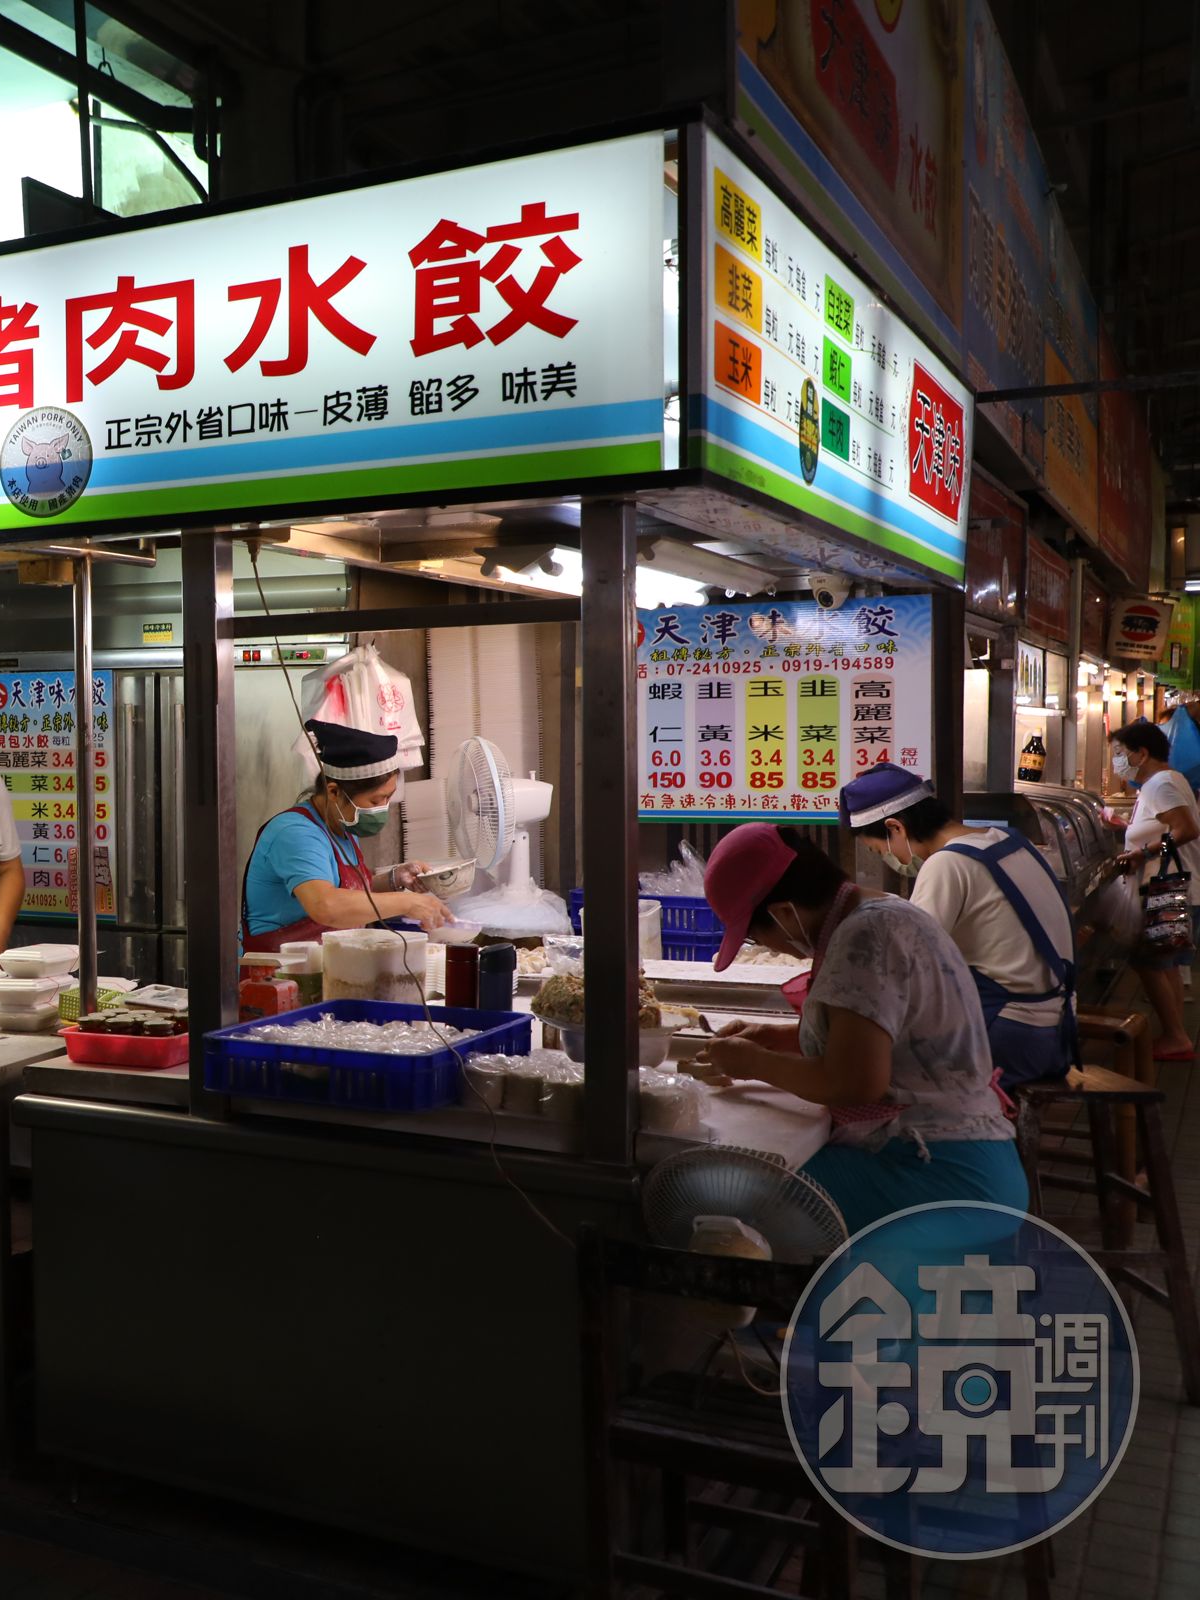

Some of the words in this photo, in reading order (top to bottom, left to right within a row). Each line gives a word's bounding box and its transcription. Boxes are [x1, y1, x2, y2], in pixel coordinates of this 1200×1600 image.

[720, 184, 758, 251] 高麗菜
[728, 263, 753, 319] 韭菜
[728, 338, 753, 391] 玉米
[408, 373, 480, 416] 餡多
[501, 361, 577, 405] 味美
[8, 415, 38, 445] TAIWAN
[41, 412, 65, 424] PORK
[65, 421, 83, 442] ONLY
[913, 389, 960, 504] 天津味
[7, 477, 39, 511] 本店使用
[782, 656, 894, 672] 0919-194589
[11, 680, 107, 709] 天津味餃
[649, 682, 683, 743] 蝦仁
[697, 682, 732, 743] 韭黃
[748, 680, 784, 742] 玉米
[800, 680, 837, 742] 韭菜
[853, 680, 892, 744] 高麗菜
[52, 735, 70, 746] 每粒
[52, 752, 74, 767] 3.4
[95, 752, 106, 767] 5
[651, 750, 681, 767] 6.0
[700, 749, 731, 766] 3.6
[750, 749, 783, 766] 3.4
[802, 749, 835, 766] 3.4
[855, 748, 890, 766] 3.4
[53, 776, 74, 791] 3.4
[95, 776, 106, 791] 5
[648, 772, 686, 788] 150
[699, 771, 732, 788] 90
[749, 771, 784, 788] 85
[801, 771, 837, 788] 85
[32, 802, 49, 818] 米
[53, 803, 75, 818] 3.4
[96, 804, 106, 818] 5
[32, 823, 49, 840] 黃
[54, 824, 75, 839] 3.6
[96, 824, 107, 840] 0
[32, 846, 50, 863] 仁
[54, 848, 68, 863] 6.
[33, 870, 50, 887] 肉
[54, 872, 67, 887] 6.
